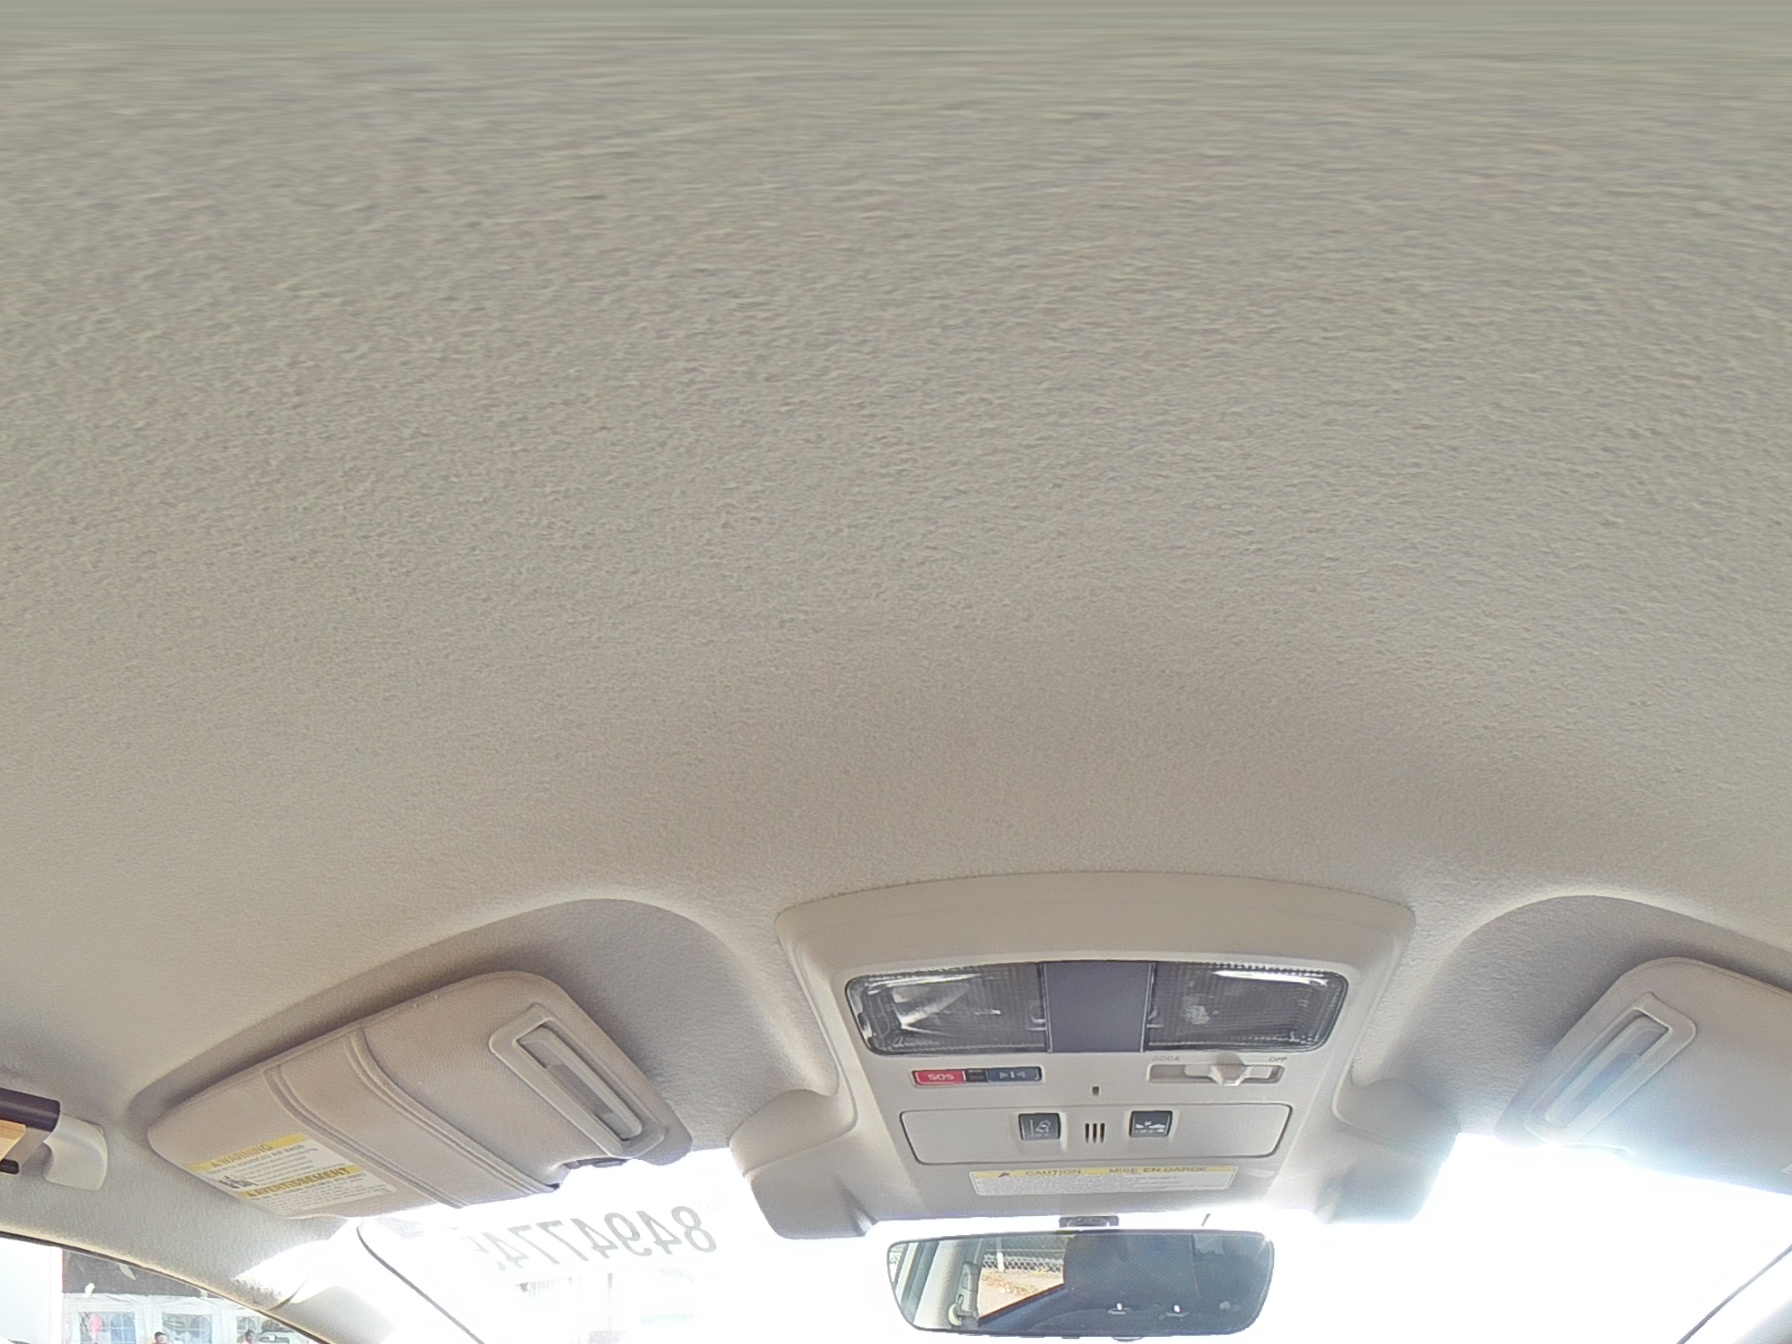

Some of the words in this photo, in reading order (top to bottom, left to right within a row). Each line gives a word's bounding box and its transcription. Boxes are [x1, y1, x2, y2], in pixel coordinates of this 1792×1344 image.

[927, 1073, 956, 1081] SOS
[216, 1143, 275, 1168] WARNING
[1025, 1168, 1082, 1176] CAUTION
[254, 1166, 350, 1196] AVERTISSEMENT
